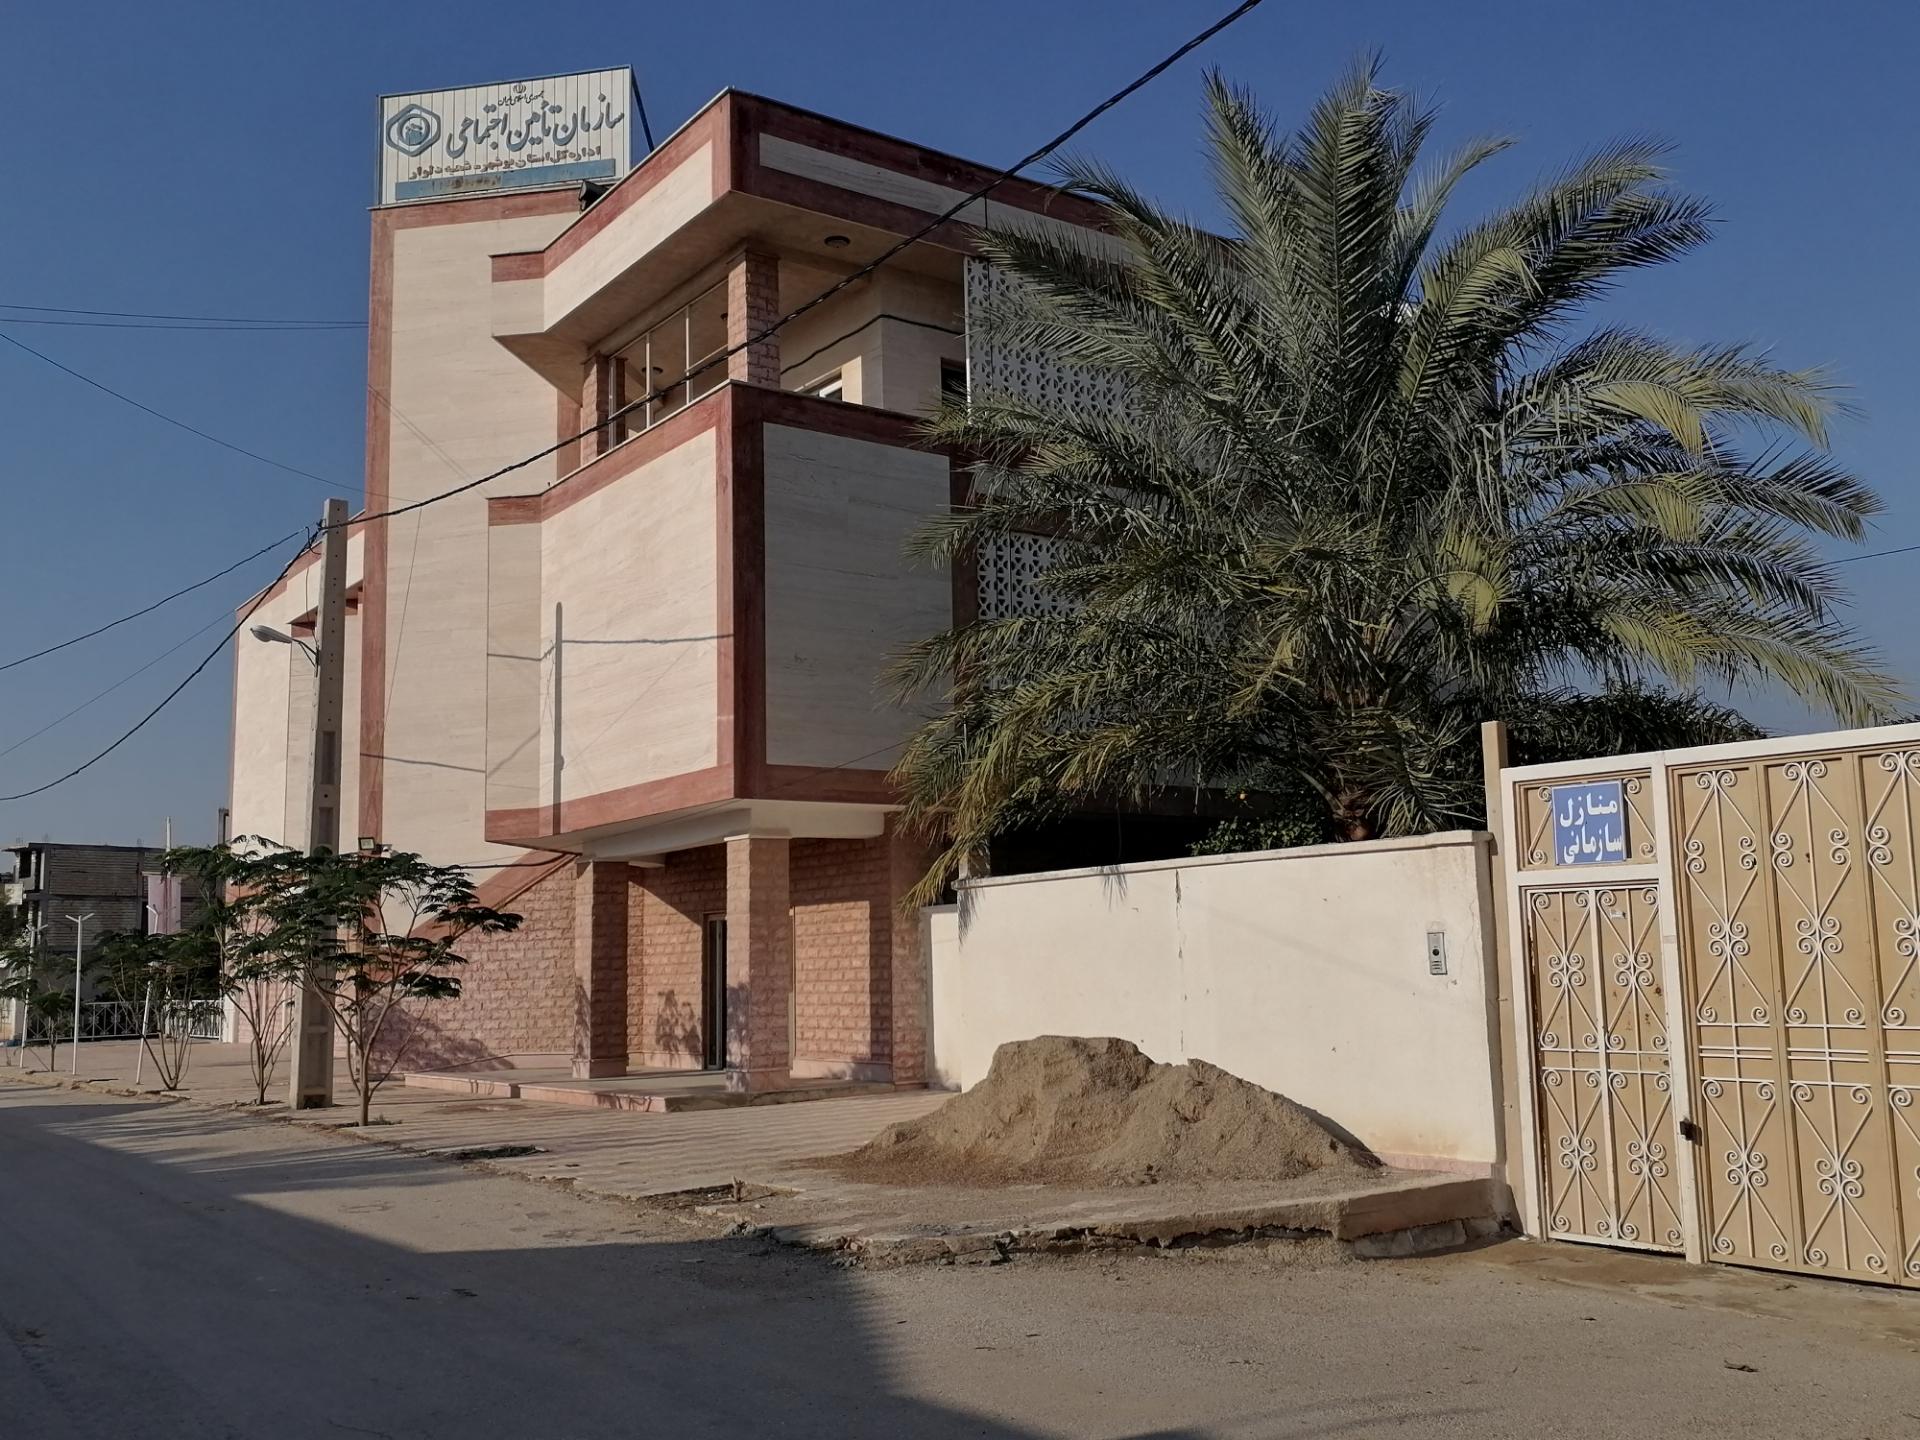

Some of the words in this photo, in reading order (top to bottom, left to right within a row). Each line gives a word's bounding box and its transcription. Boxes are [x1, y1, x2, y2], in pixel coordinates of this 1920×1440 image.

[552, 93, 625, 146] سازمان
[446, 103, 508, 159] اجتماعی
[514, 151, 551, 168] استان
[549, 150, 569, 164] کل
[567, 145, 602, 162] اداره
[409, 164, 444, 180] دلوار
[480, 156, 515, 173] بوشهر
[1559, 792, 1618, 828] منازل
[1563, 822, 1624, 864] سازمانی
